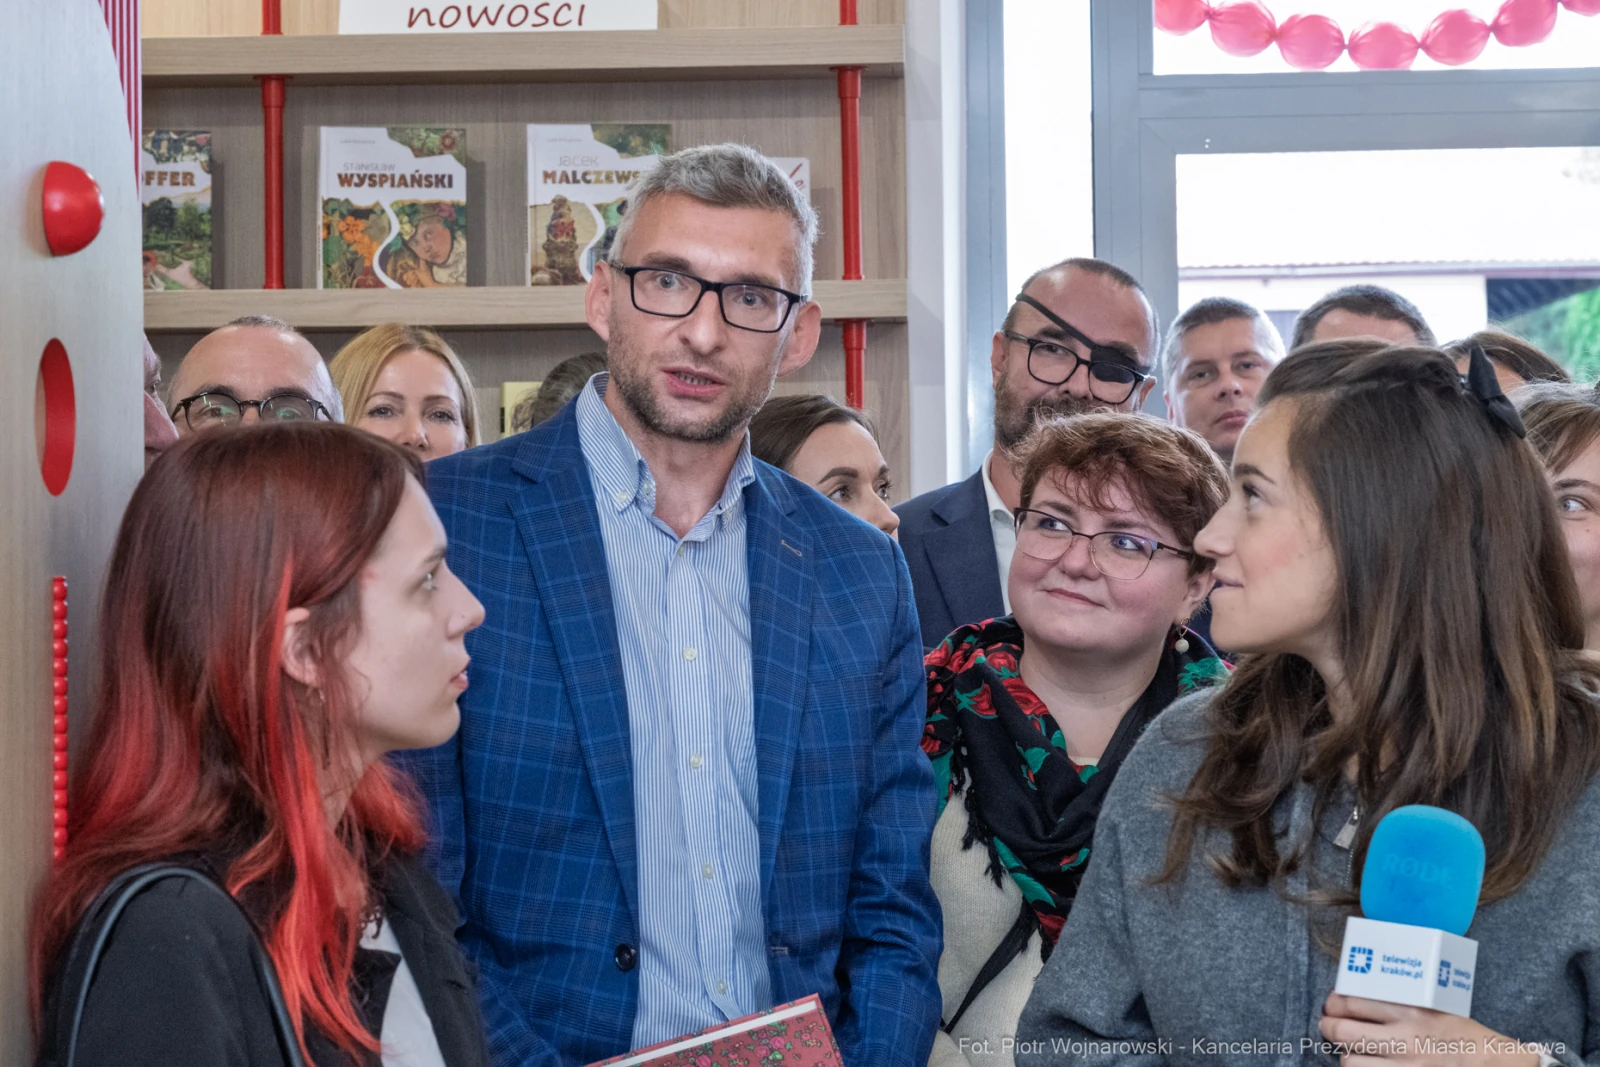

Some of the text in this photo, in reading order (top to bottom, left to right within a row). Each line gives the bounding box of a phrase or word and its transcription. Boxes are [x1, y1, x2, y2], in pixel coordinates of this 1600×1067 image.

[142, 170, 195, 187] FFER
[337, 169, 454, 189] WYSPIAŃSKI
[1382, 954, 1422, 968] telewizja
[1381, 965, 1424, 980] kraków.pl
